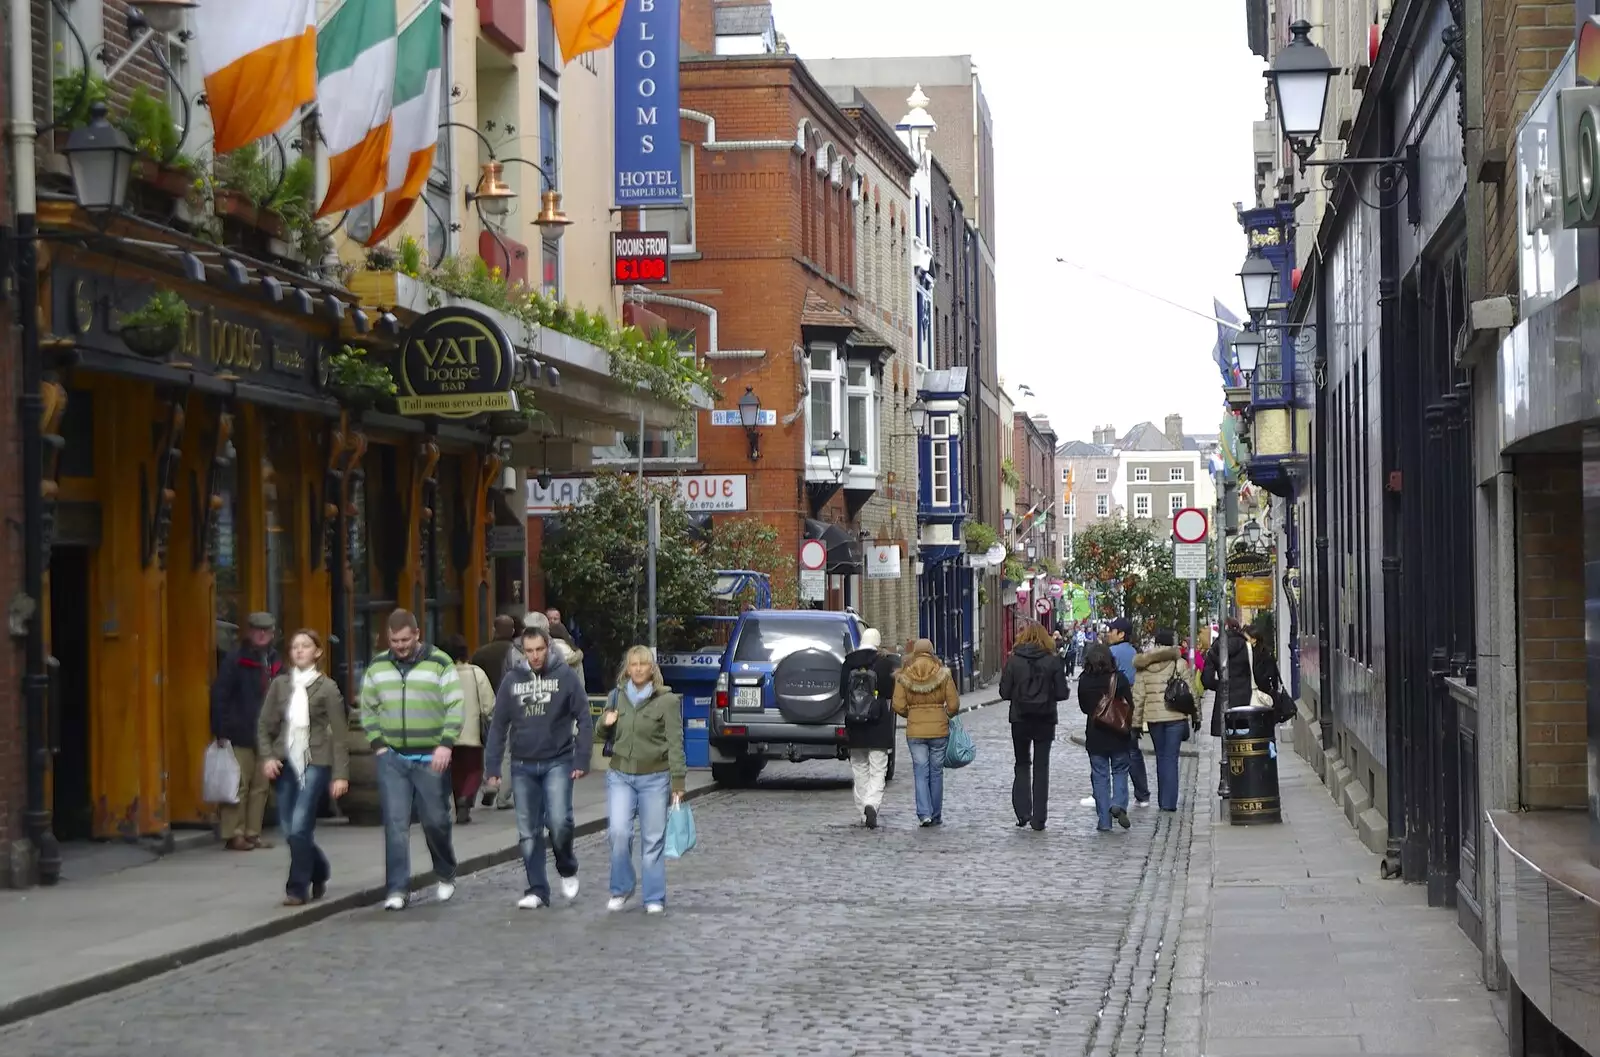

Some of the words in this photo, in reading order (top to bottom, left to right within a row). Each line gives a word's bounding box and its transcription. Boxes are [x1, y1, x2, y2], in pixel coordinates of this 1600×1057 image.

[637, 0, 658, 154] BLOOMS
[620, 170, 677, 187] HOTEL
[620, 188, 656, 198] TEMPLE
[657, 187, 678, 197] BAR
[616, 238, 644, 256] ROOMS
[645, 237, 667, 256] FROM
[416, 336, 486, 366] VAT
[441, 382, 466, 391] BAR
[424, 401, 450, 410] menu
[451, 397, 482, 408] served
[485, 395, 508, 408] daily
[690, 655, 713, 665] 540
[525, 703, 546, 717] ATHL
